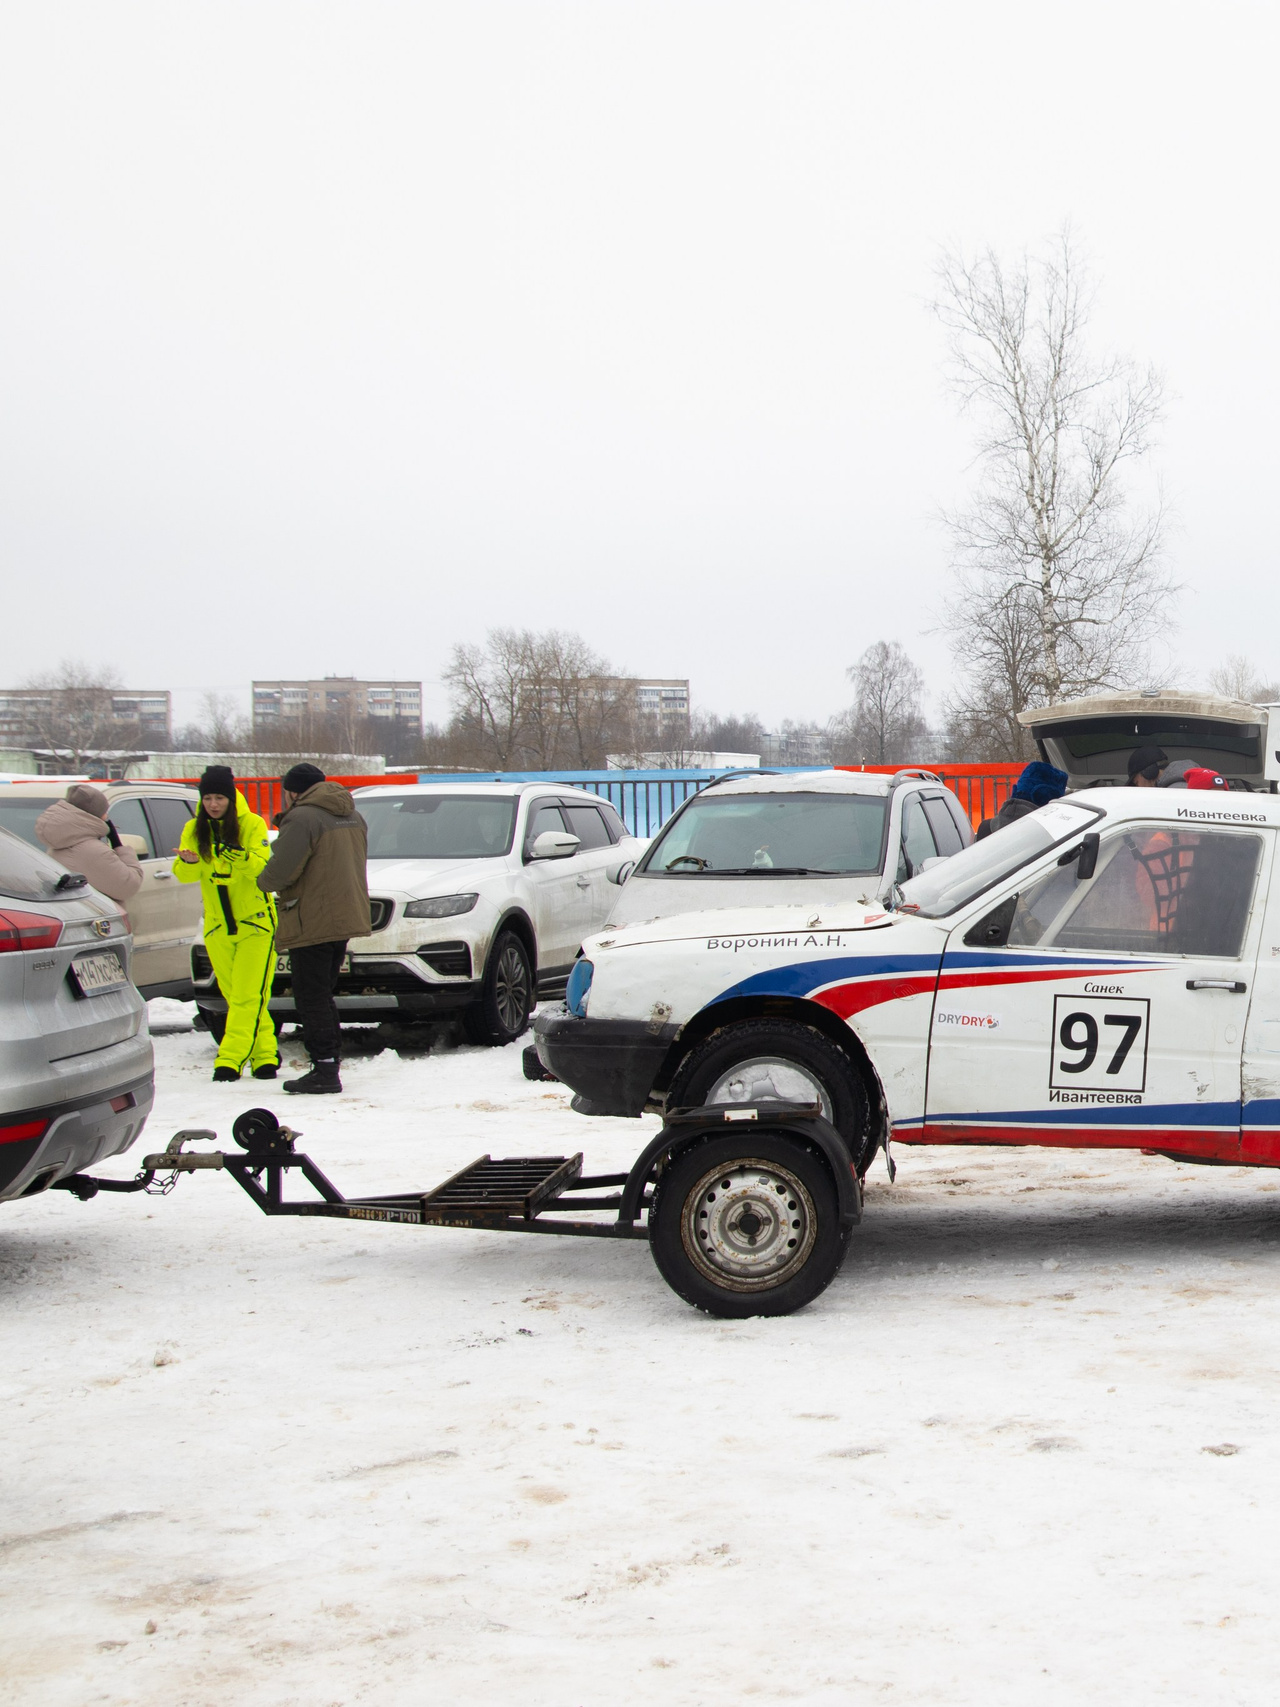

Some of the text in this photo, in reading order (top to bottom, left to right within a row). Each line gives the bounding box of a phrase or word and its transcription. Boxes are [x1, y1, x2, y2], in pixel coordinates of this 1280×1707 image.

[1177, 808, 1267, 822] Ивантеевка
[707, 935, 847, 953] Воронин А.Н.
[1084, 982, 1125, 994] Санек
[938, 1013, 985, 1027] DRYDRY
[1060, 1012, 1142, 1074] 97
[1049, 1089, 1142, 1104] Ивантеевка
